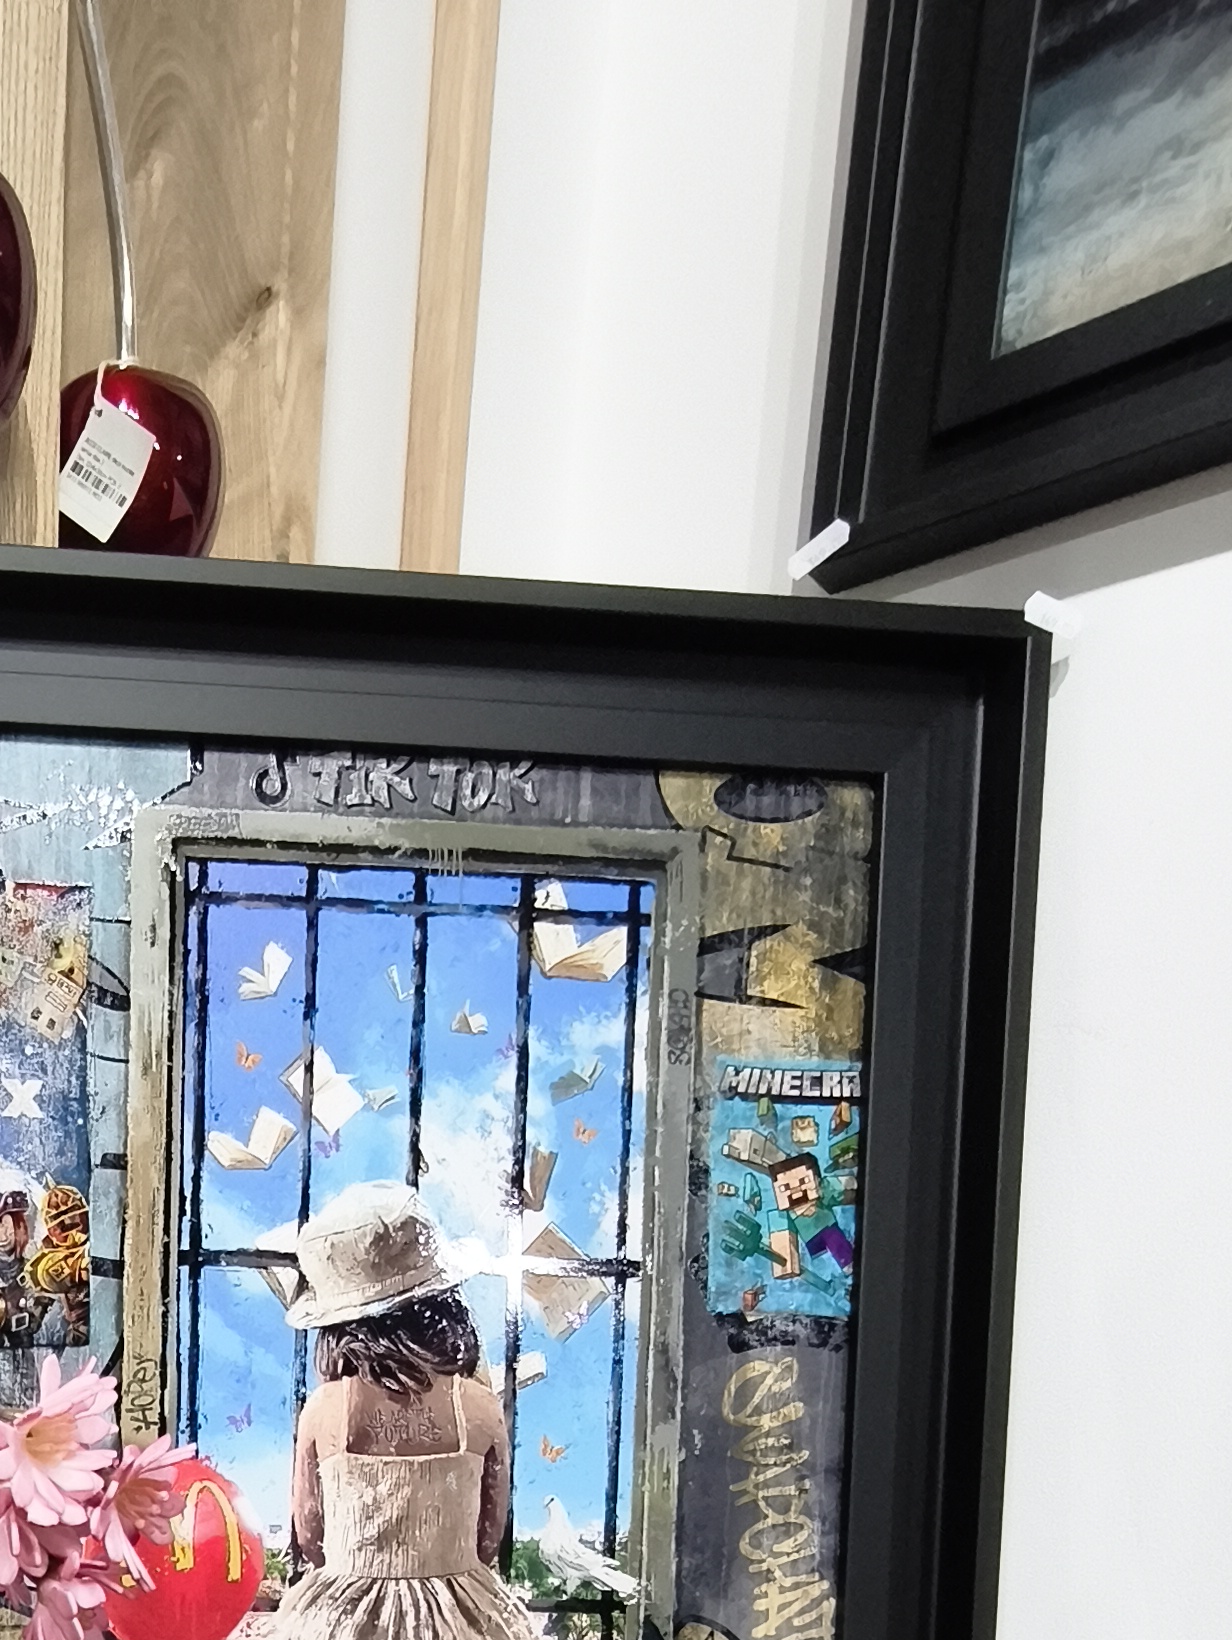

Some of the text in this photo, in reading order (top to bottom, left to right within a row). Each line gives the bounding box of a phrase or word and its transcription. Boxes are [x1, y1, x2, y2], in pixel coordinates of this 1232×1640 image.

[308, 750, 539, 816] TIK TOK
[719, 1065, 862, 1098] MINECRA
